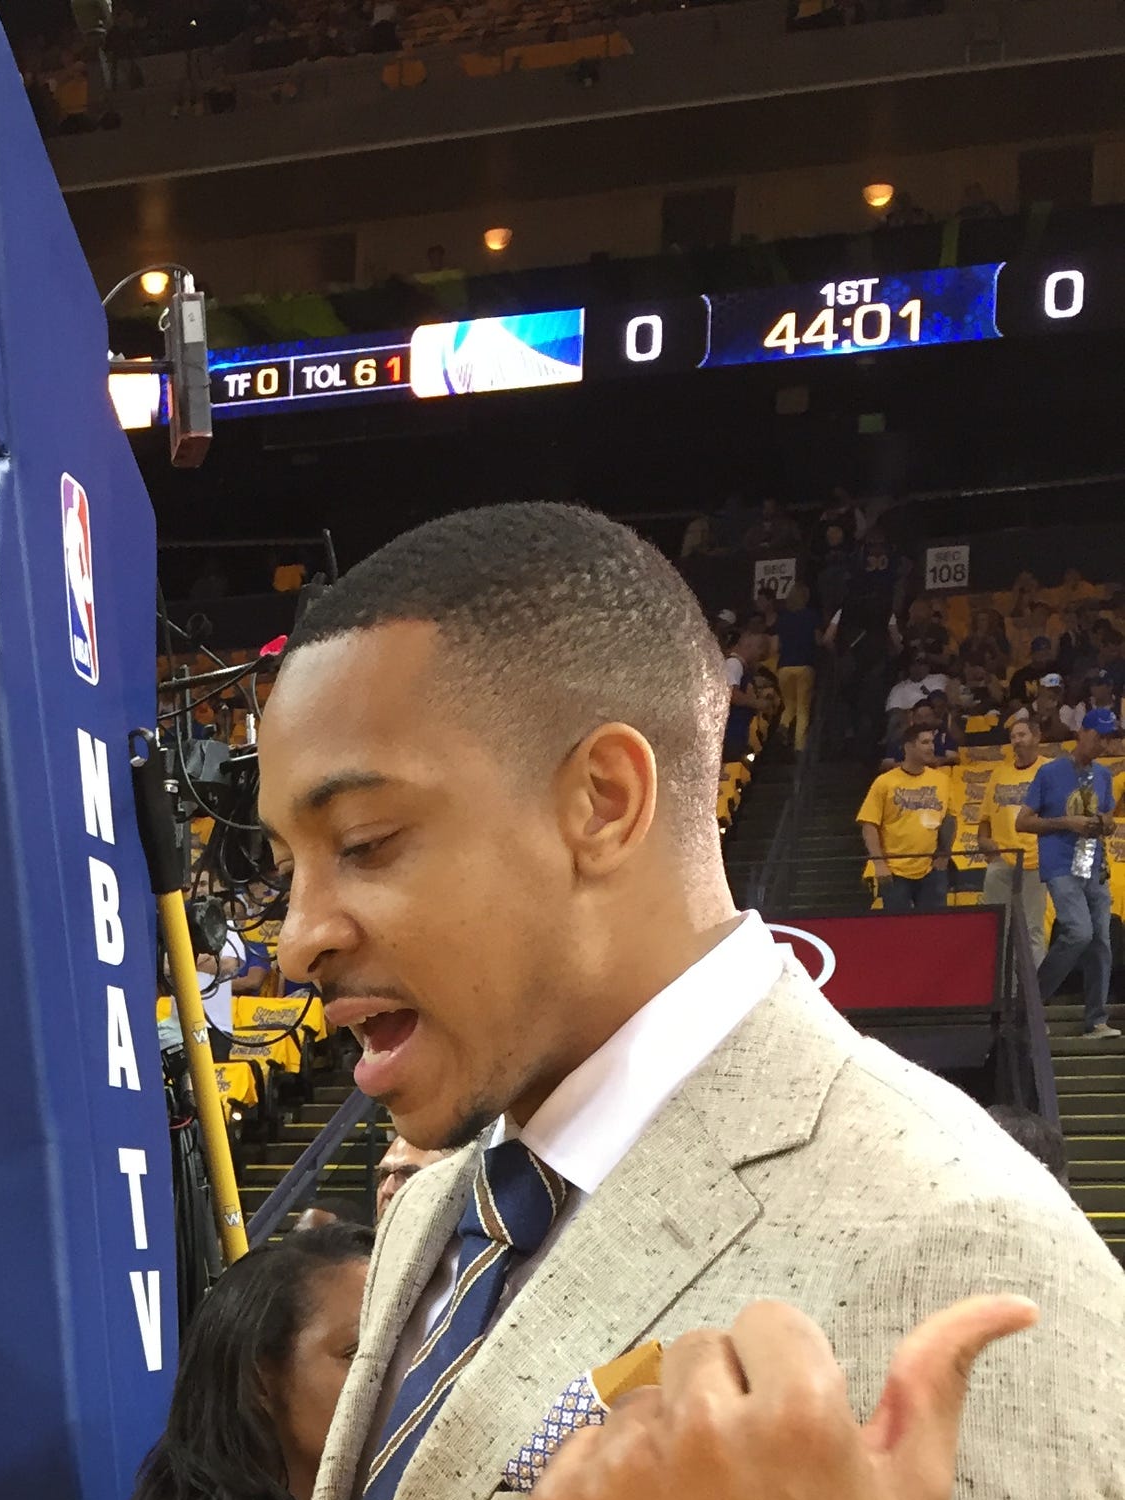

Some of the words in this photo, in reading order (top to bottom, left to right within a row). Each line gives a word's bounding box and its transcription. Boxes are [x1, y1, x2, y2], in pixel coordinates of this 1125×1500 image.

[819, 278, 880, 307] 1ST
[1044, 270, 1085, 319] 0
[625, 315, 663, 362] 0
[763, 300, 923, 355] 44:01
[224, 372, 252, 397] TF
[256, 368, 279, 395] 0
[301, 362, 347, 390] TOL
[354, 358, 377, 387] 6
[385, 355, 401, 382] 1
[929, 563, 967, 584] 108
[77, 727, 142, 1091] NBA
[118, 1147, 163, 1372] TV
